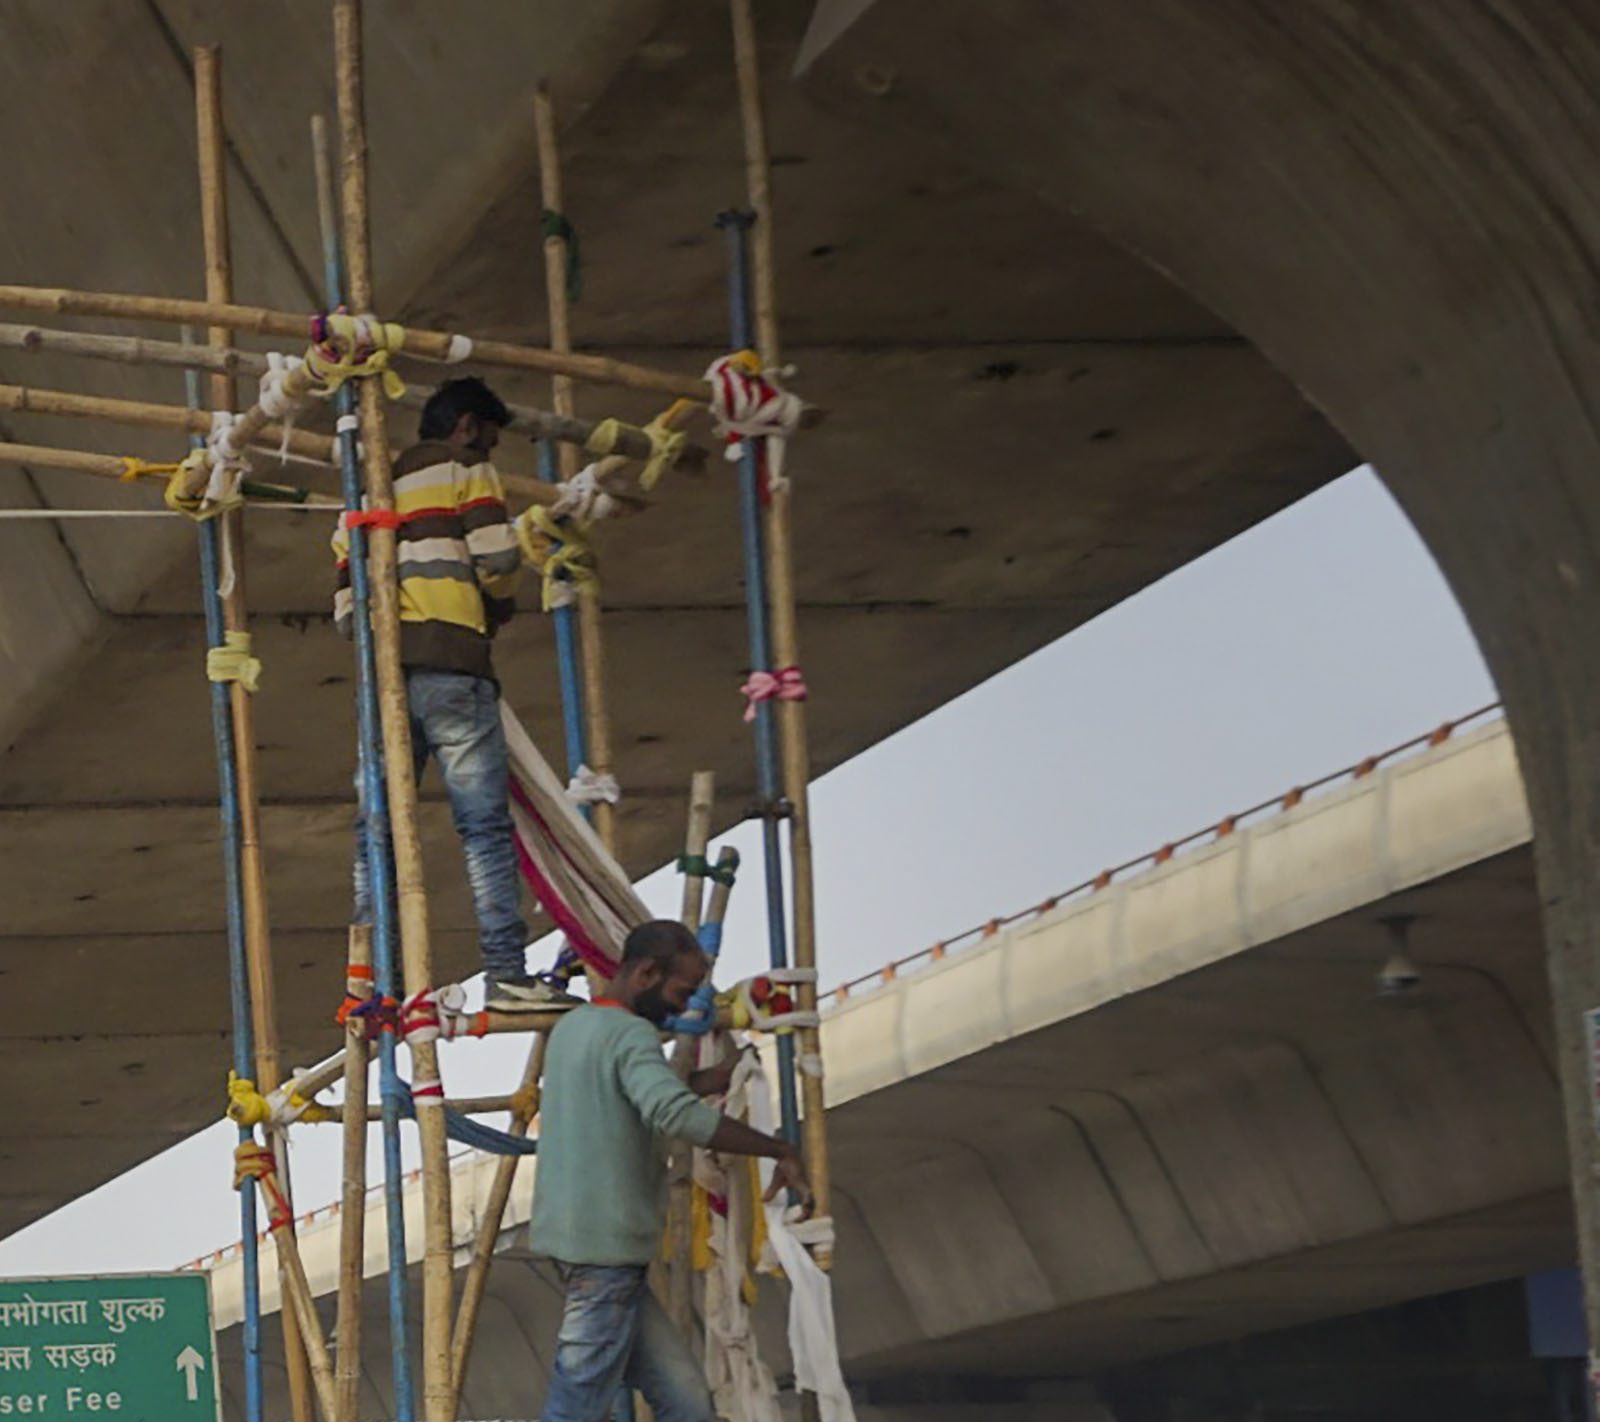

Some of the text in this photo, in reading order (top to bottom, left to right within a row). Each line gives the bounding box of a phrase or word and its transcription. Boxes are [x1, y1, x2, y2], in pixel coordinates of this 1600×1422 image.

[100, 1297, 165, 1333] शुल्क
[43, 1343, 116, 1373] सड़क
[66, 1387, 122, 1411] Fee
